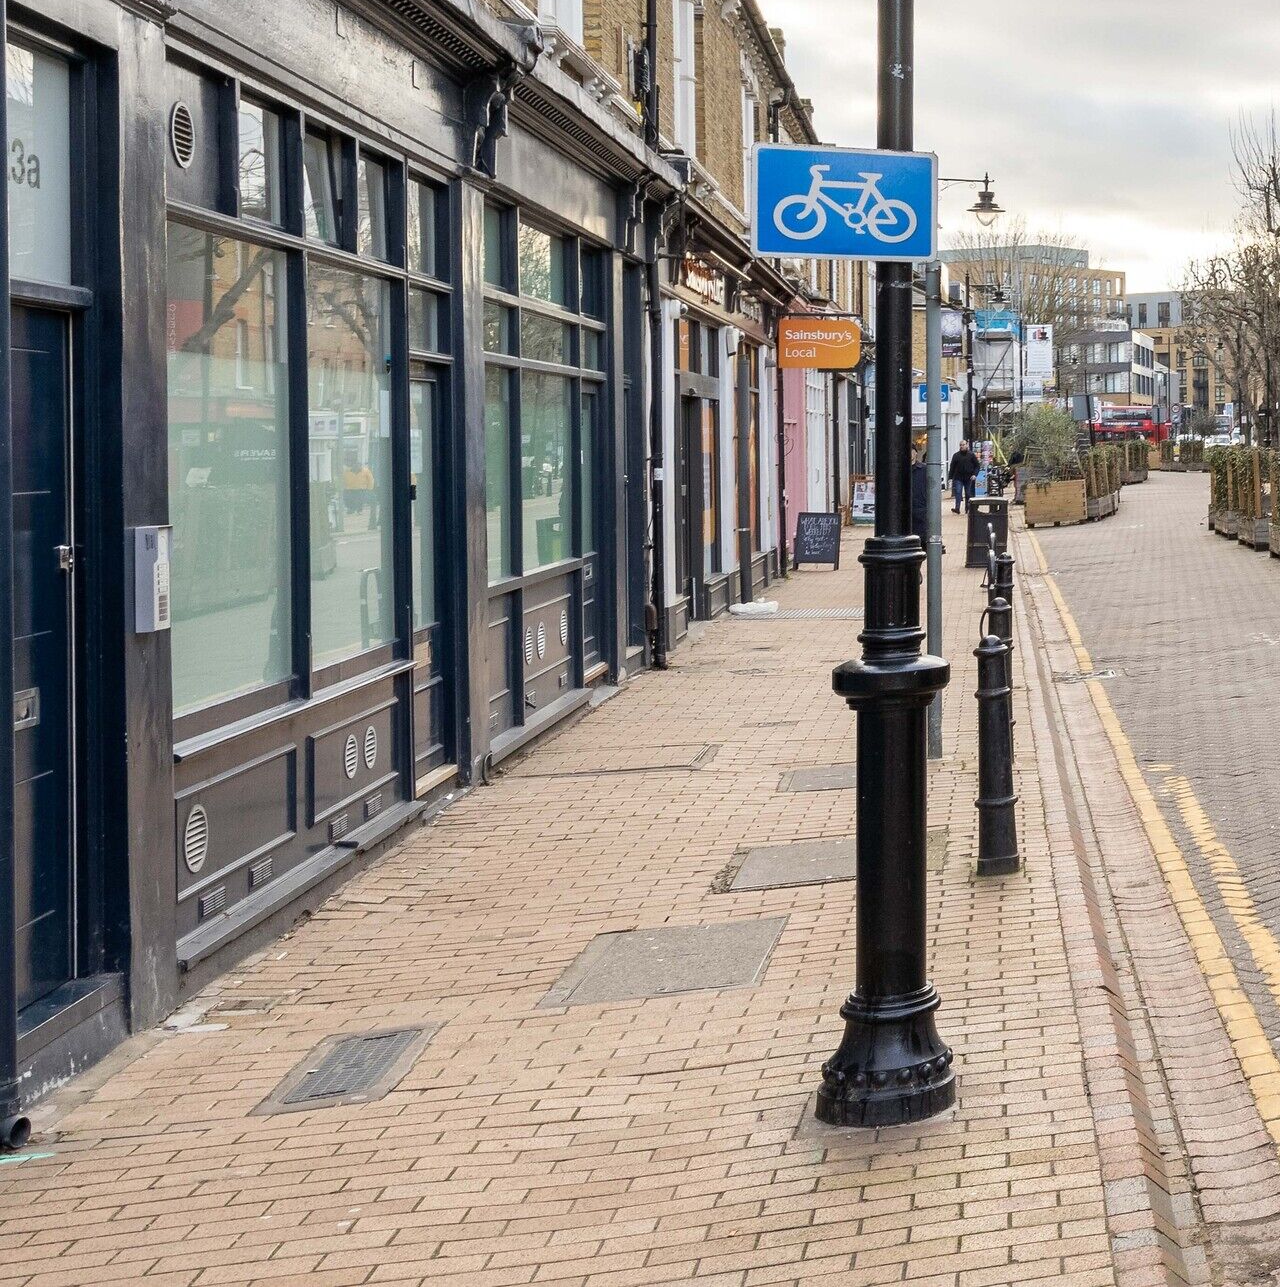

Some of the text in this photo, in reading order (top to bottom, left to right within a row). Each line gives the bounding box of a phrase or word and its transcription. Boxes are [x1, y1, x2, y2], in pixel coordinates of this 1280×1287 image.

[8, 138, 40, 189] 3a
[785, 329, 852, 343] Sainsbury's
[785, 347, 816, 358] Local
